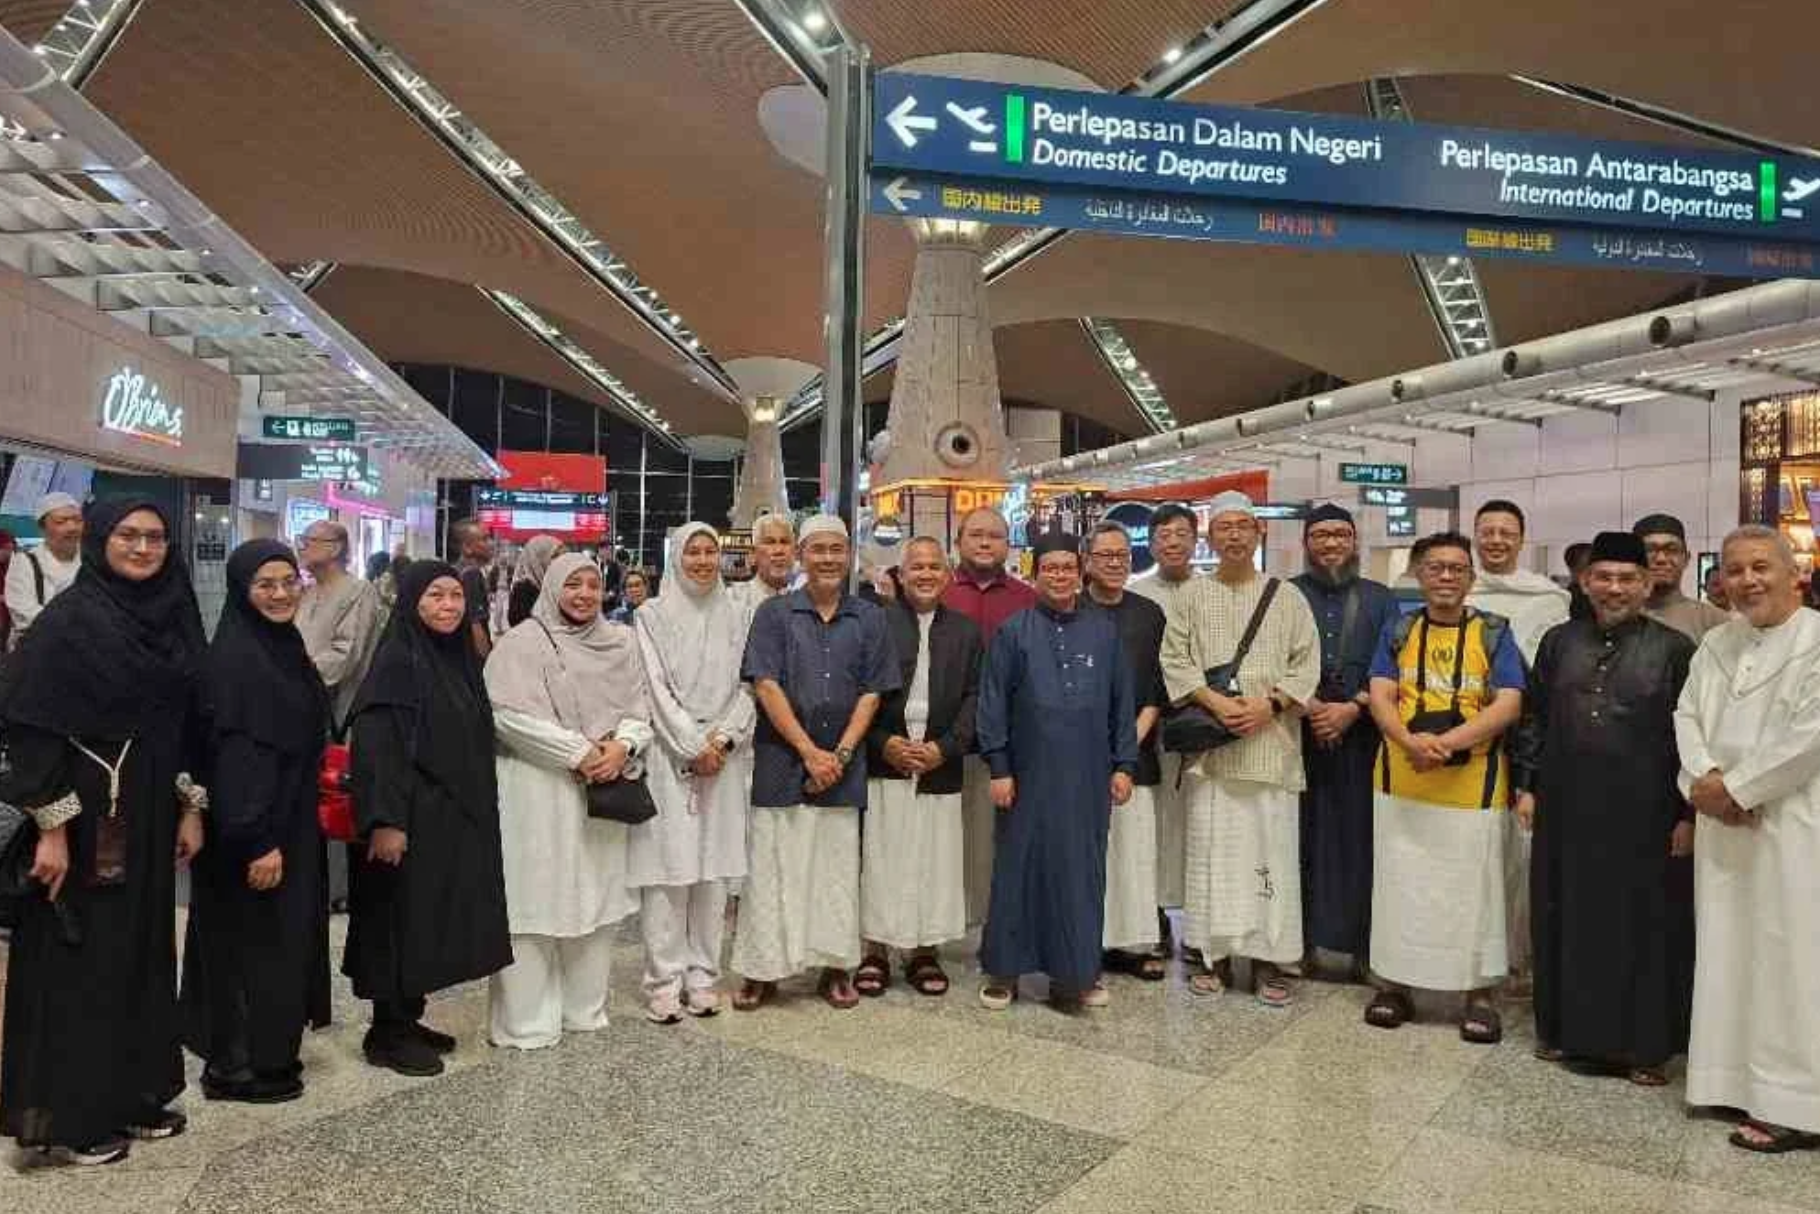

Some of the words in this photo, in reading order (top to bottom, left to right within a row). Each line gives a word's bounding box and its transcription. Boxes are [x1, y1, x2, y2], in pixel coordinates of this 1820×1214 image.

[1033, 102, 1185, 145] Perlepasan
[1194, 117, 1282, 151] Dalam
[1290, 126, 1382, 164] Negeri
[1032, 138, 1148, 172] Domestic
[1156, 150, 1288, 184] Departures
[1440, 140, 1578, 177] Perlepasan
[1585, 152, 1754, 196] Antarabangsa
[1501, 178, 1635, 211] International
[1642, 189, 1754, 221] Departures
